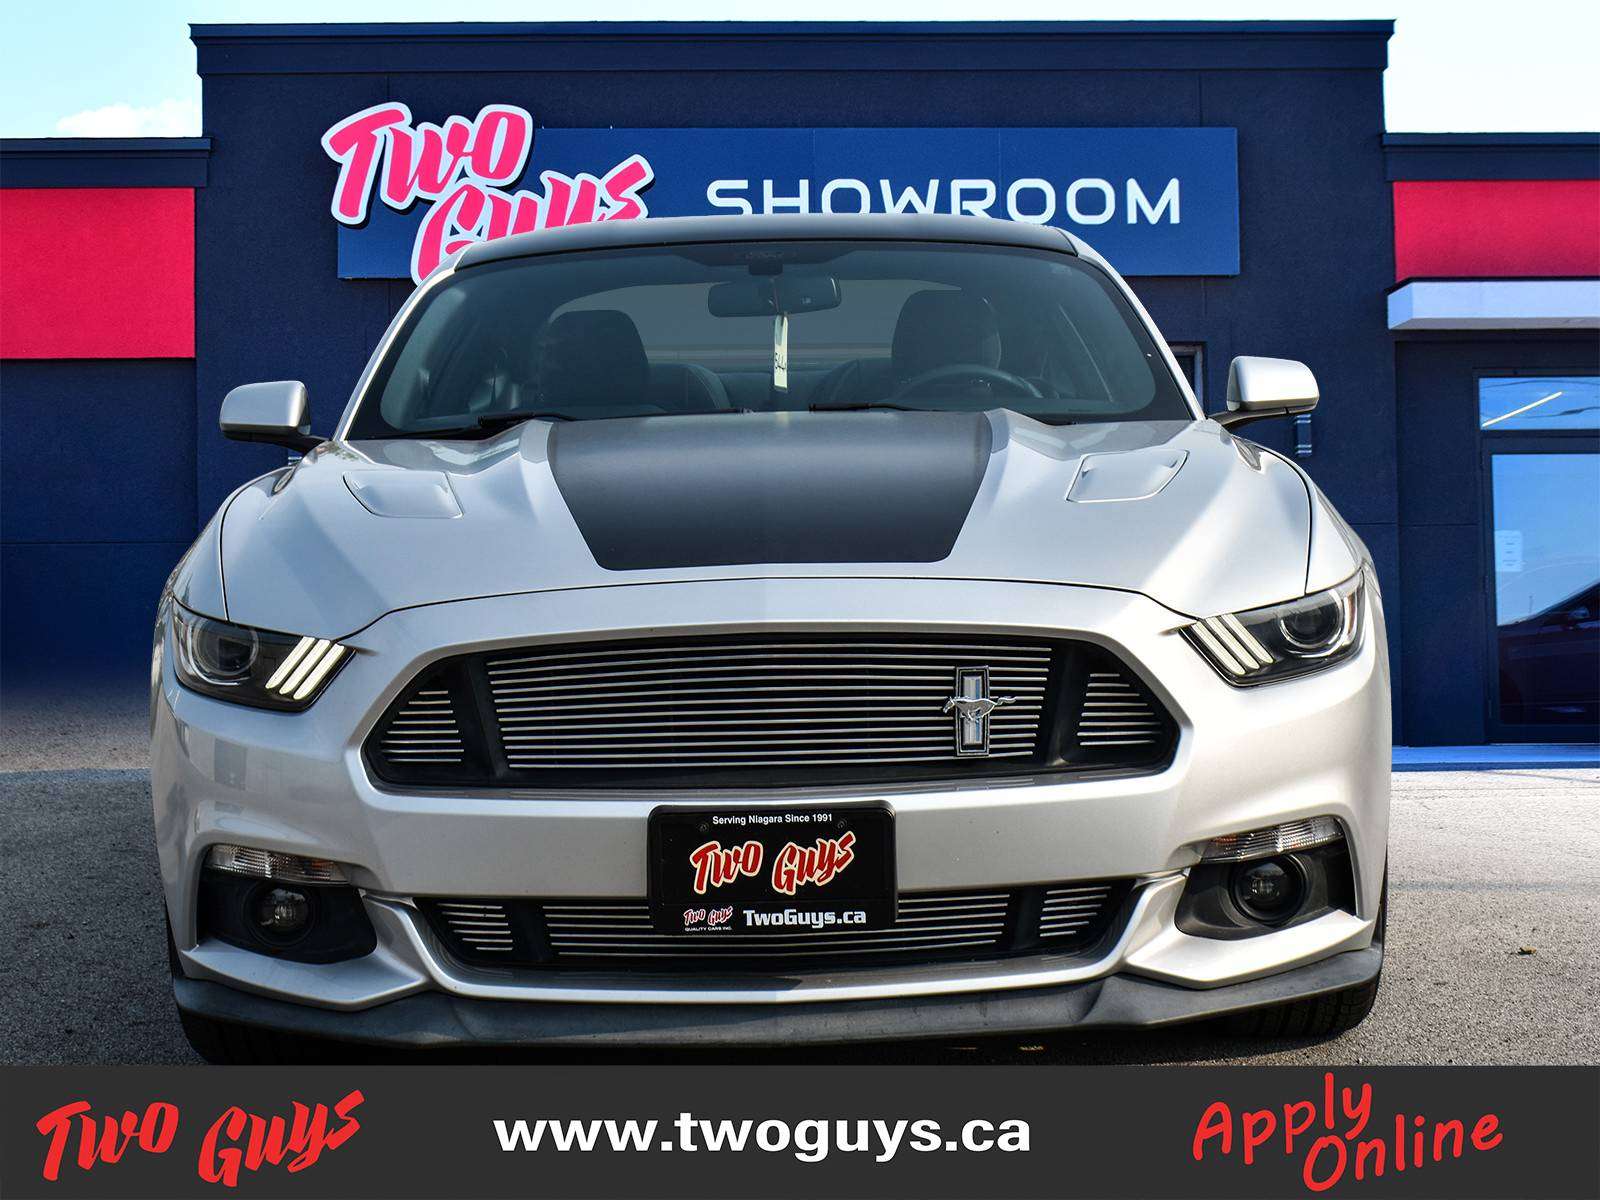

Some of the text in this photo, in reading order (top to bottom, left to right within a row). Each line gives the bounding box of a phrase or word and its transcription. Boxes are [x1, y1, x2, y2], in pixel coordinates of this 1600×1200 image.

[321, 102, 533, 225] Two
[706, 178, 1180, 225] SHOWROOM
[712, 813, 833, 826] Serving Niagara Since 1991
[690, 831, 856, 895] Two Guys
[683, 906, 733, 926] Two Guys
[743, 909, 867, 929] TwoGuys.ca
